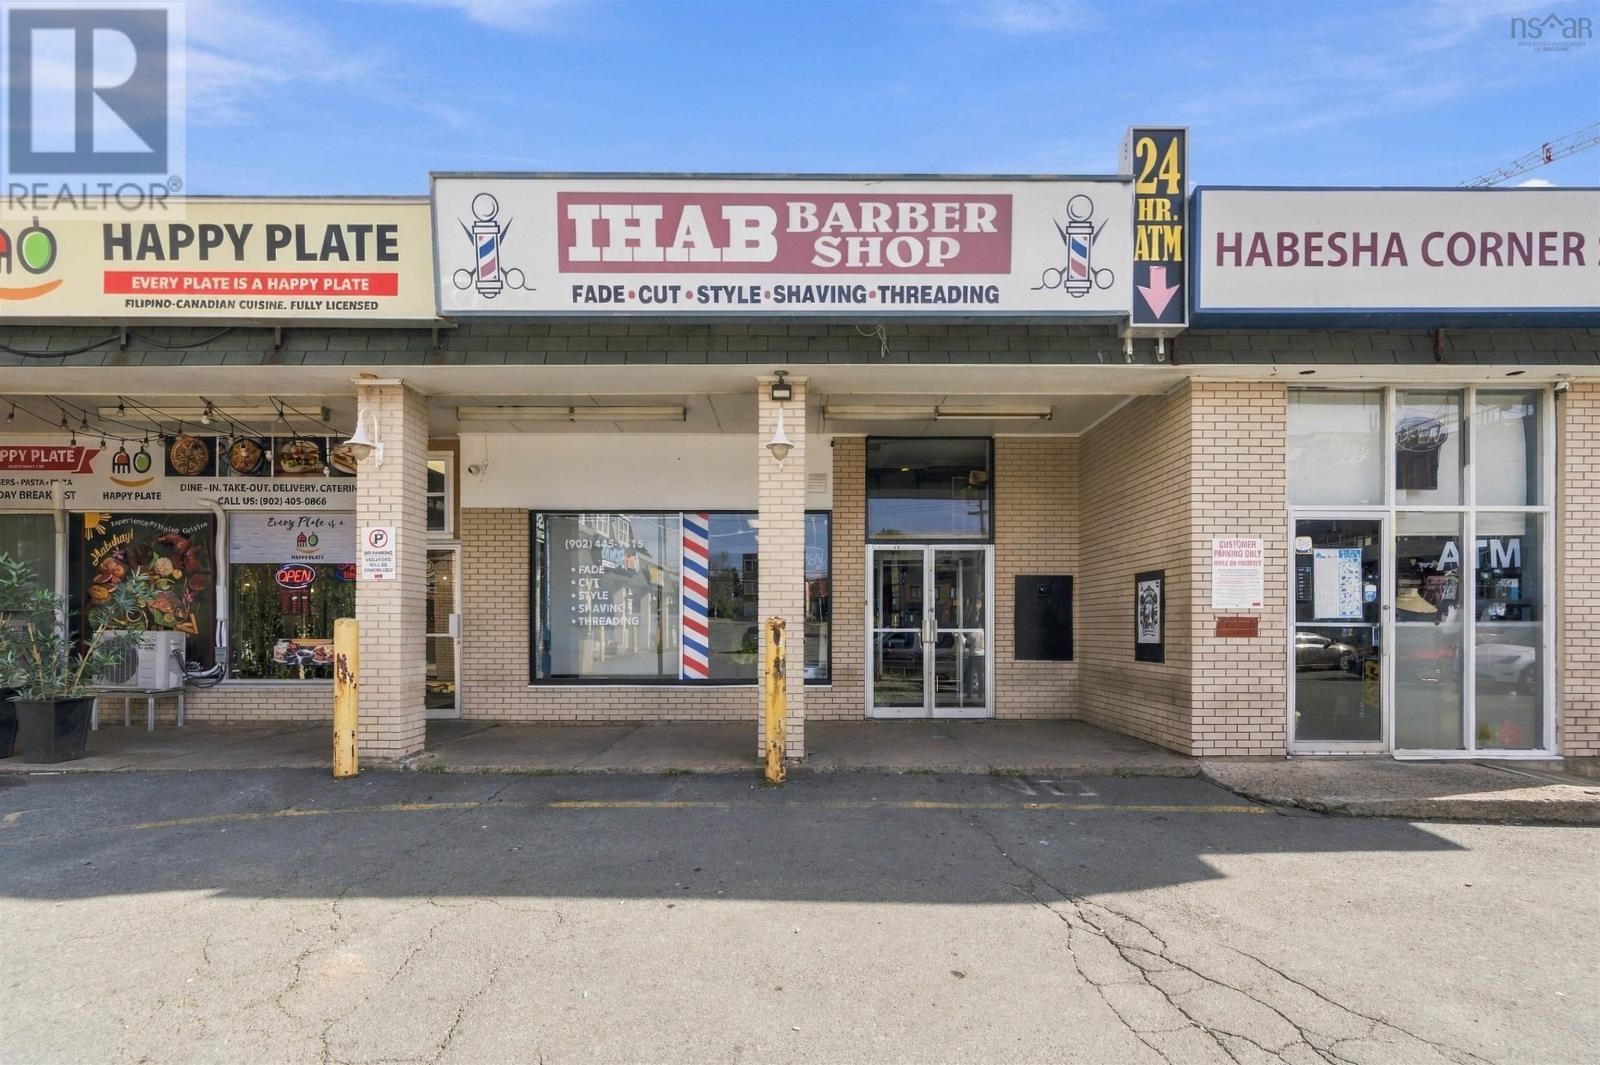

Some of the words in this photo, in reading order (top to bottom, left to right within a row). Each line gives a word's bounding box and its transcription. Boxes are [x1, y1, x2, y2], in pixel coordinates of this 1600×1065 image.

[1135, 136, 1181, 194] 24
[1138, 198, 1179, 221] HR.
[567, 204, 777, 263] IHAB
[786, 202, 998, 233] BARBER
[103, 223, 253, 261] HAPPY
[266, 224, 399, 262] PLATE
[1134, 225, 1183, 261] ATM
[811, 236, 961, 267] SHOP
[1216, 231, 1408, 267] HABESHA
[1421, 231, 1586, 267] CORNER
[131, 276, 177, 289] EVERY
[183, 277, 229, 289] PLATE
[233, 277, 247, 290] IS
[251, 278, 263, 290] A
[267, 277, 318, 290] HAPPY
[323, 278, 370, 290] PLATE
[572, 285, 625, 304] FADE
[638, 285, 681, 304] CUT
[696, 285, 762, 304] STYLE
[773, 285, 867, 304] SHAVING
[877, 286, 1000, 304] THREADING
[125, 299, 236, 310] FILIPINO-CANADIAN
[239, 300, 288, 310] CUISINE.
[290, 301, 325, 310] FULLY
[327, 301, 379, 311] LICENSED
[0, 449, 28, 462] PPY
[31, 449, 75, 463] PLATE
[272, 483, 319, 493] DELIVERY.
[19, 490, 77, 500] BREAKST
[103, 491, 132, 501] HAPPY
[134, 492, 162, 501] PLATE
[217, 496, 241, 506] CALL
[243, 496, 258, 506] US:
[260, 496, 283, 507] (902)
[285, 496, 328, 506] 405-0866
[267, 517, 296, 531] Every
[297, 516, 325, 527] Plate
[565, 538, 593, 550] (902)
[1214, 550, 1243, 558] PARKING
[1244, 550, 1262, 558] ONLY
[277, 569, 312, 582] OPEN
[578, 565, 606, 574] FADE
[578, 578, 600, 588] CUT
[578, 591, 609, 600] STYLE
[578, 603, 625, 613] SHAVING
[578, 616, 640, 626] THREADING
